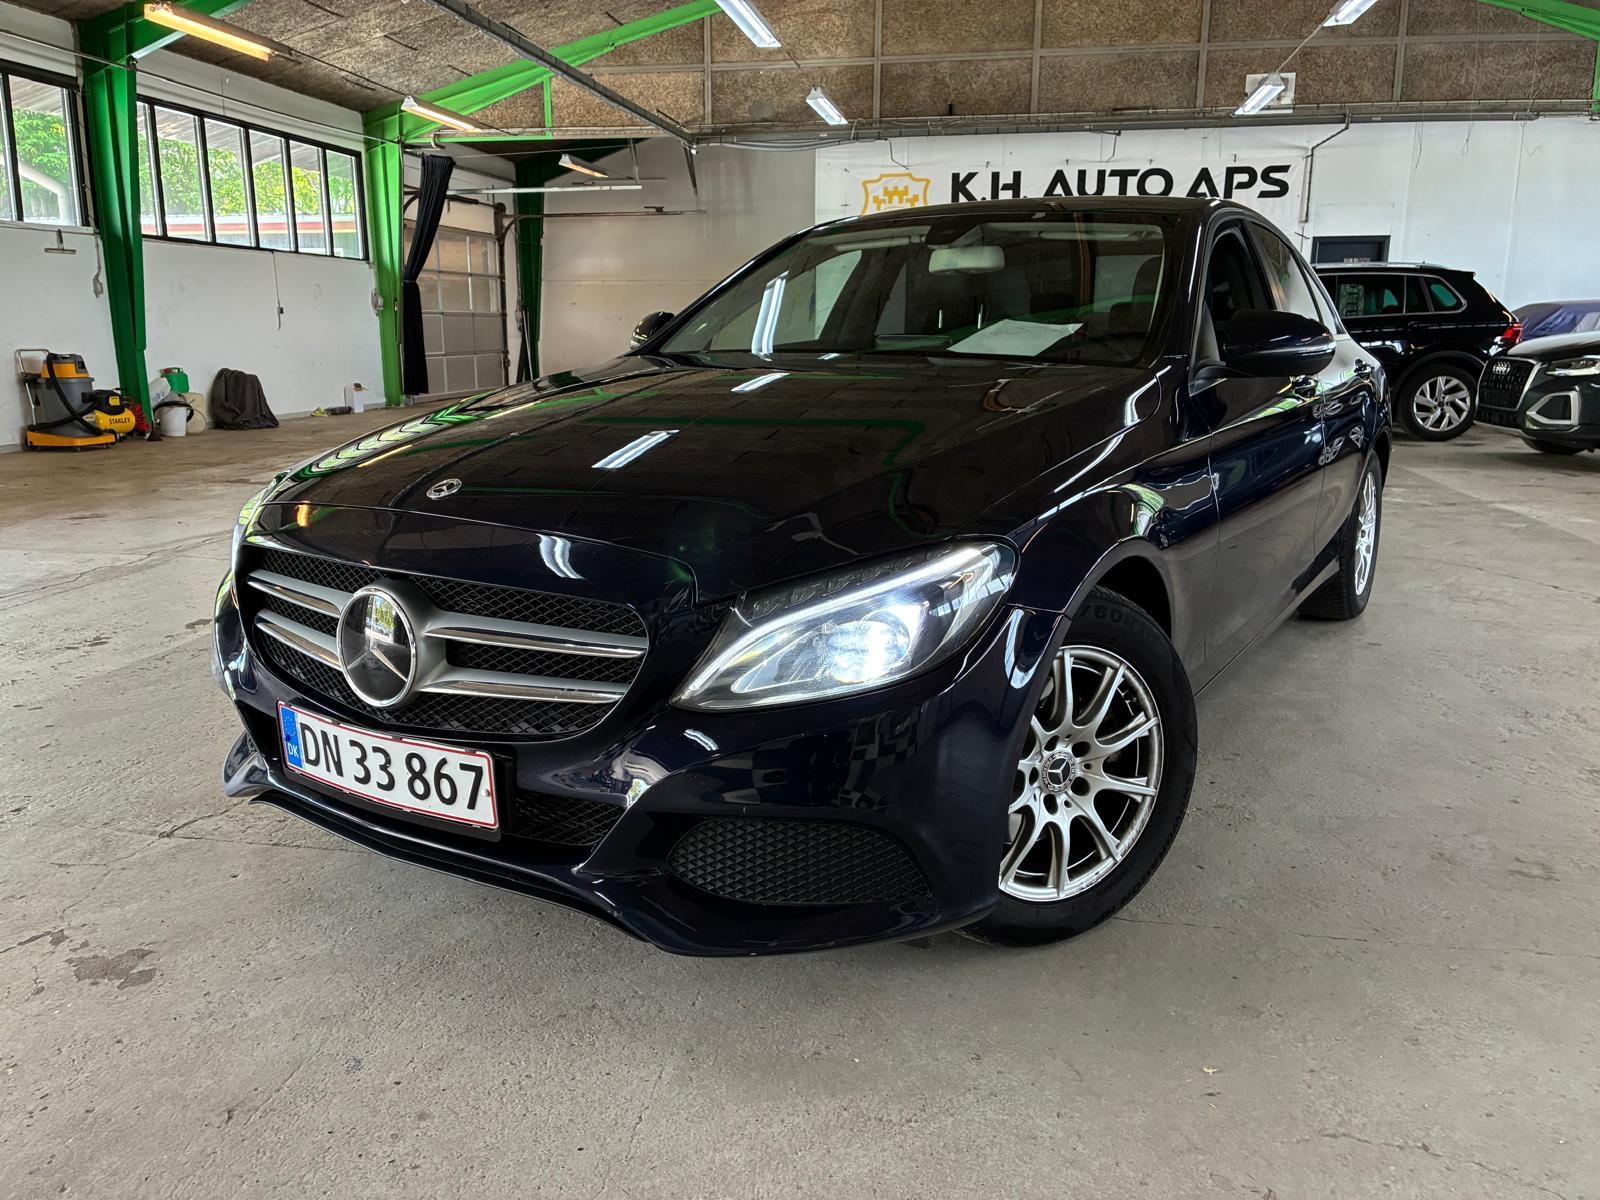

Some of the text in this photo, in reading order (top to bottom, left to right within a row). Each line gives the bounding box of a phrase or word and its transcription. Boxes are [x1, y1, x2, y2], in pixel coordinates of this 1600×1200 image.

[1043, 167, 1174, 198] AUTO
[1186, 164, 1292, 200] APS
[108, 416, 131, 425] STANLEY
[287, 742, 299, 759] DK
[300, 722, 484, 811] DN 33 867
